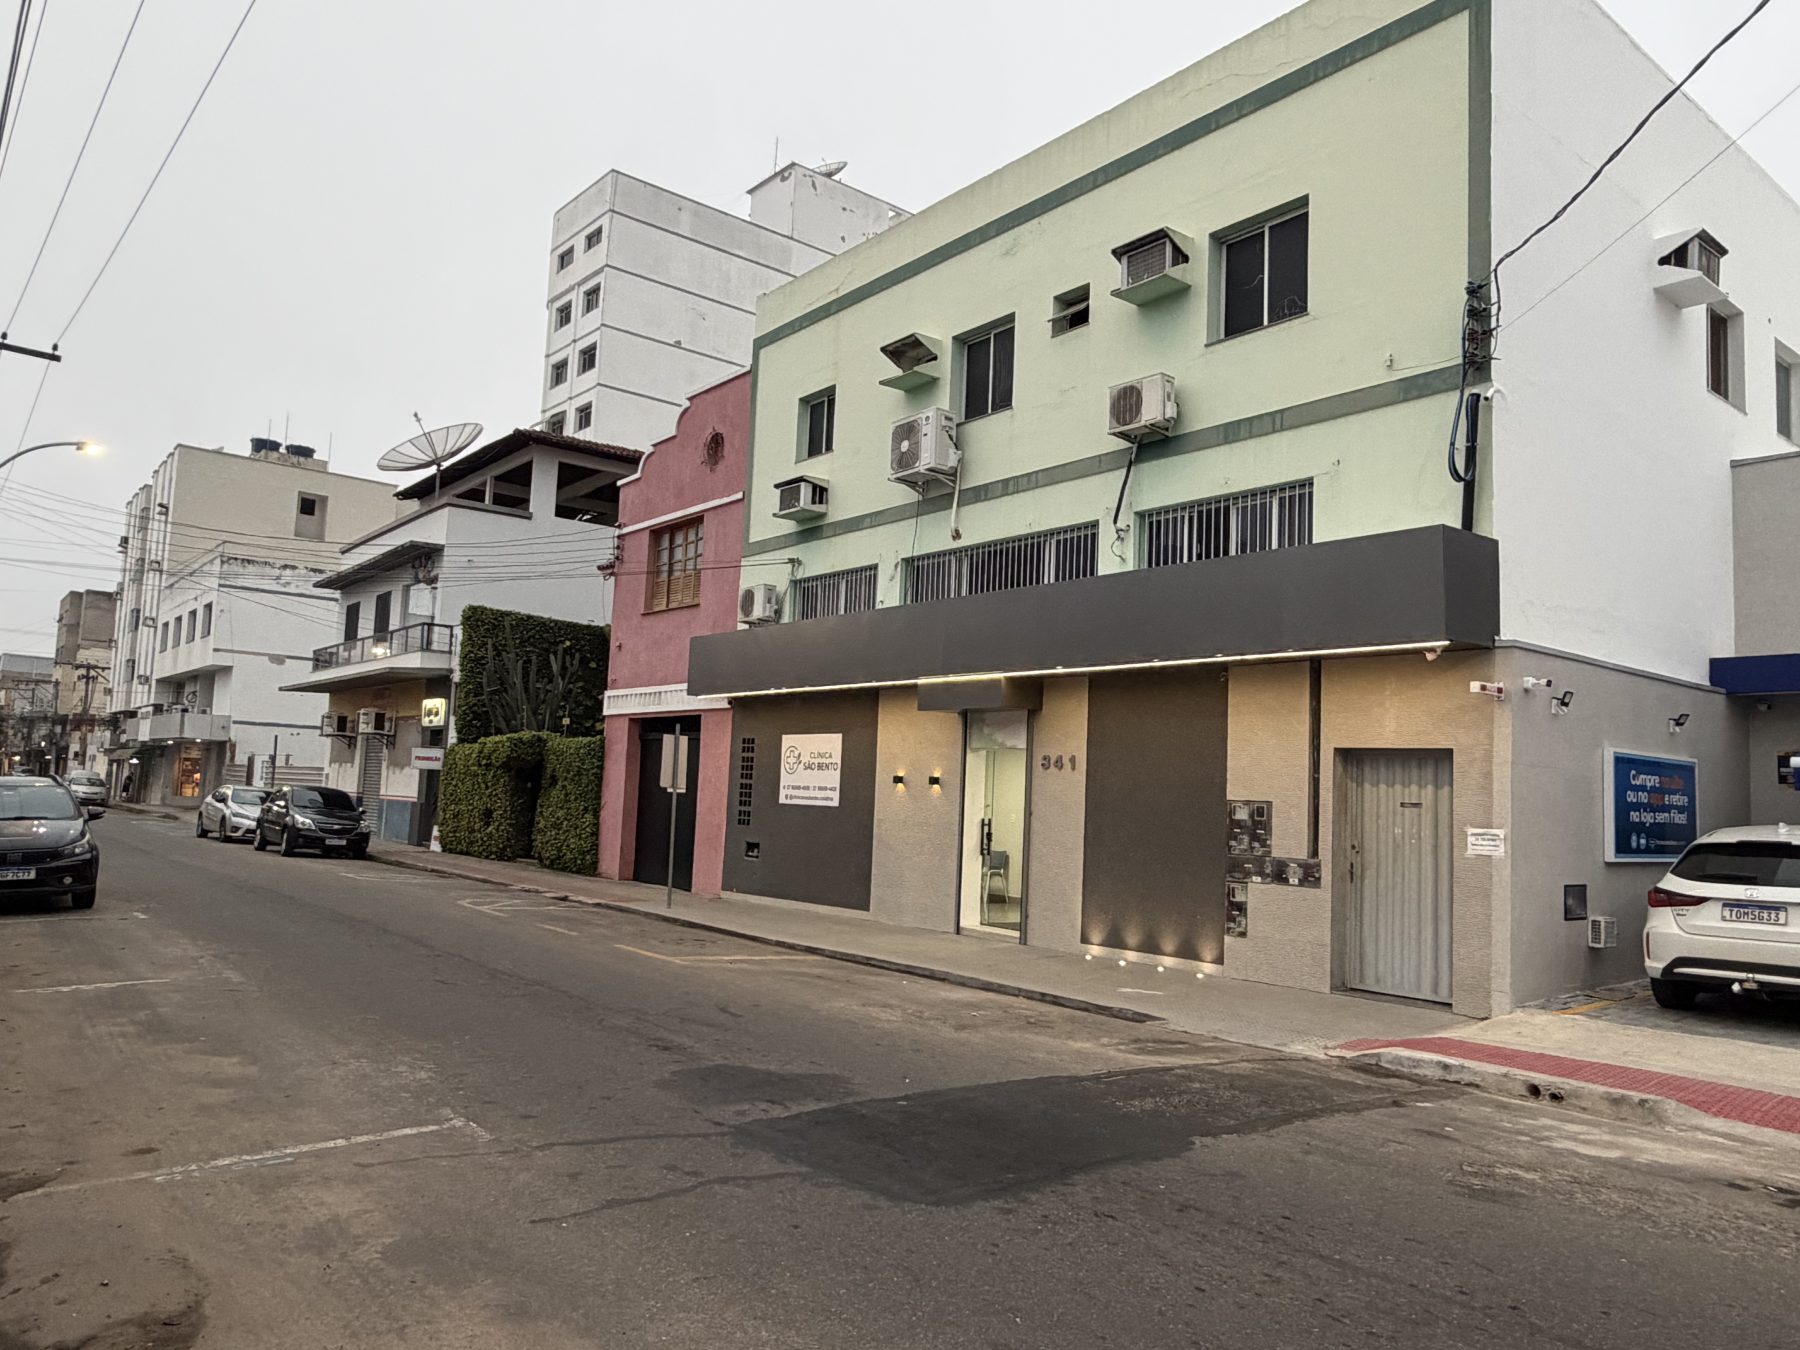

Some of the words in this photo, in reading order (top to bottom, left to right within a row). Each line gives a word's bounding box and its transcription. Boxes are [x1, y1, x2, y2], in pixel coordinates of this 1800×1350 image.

[809, 751, 832, 759] CLÍNICA
[1041, 754, 1076, 771] 341
[803, 760, 816, 771] SÃO
[816, 762, 838, 771] BENTO
[1630, 769, 1660, 789] Compre
[1626, 790, 1637, 802] ou
[1638, 791, 1648, 803] no
[1664, 794, 1670, 805] e
[1670, 792, 1689, 806] retire
[1630, 810, 1640, 822] na
[1641, 808, 1654, 827] loja
[1655, 812, 1670, 823] sem
[1670, 810, 1688, 824] filas!
[1728, 909, 1780, 922] TOM5G33
